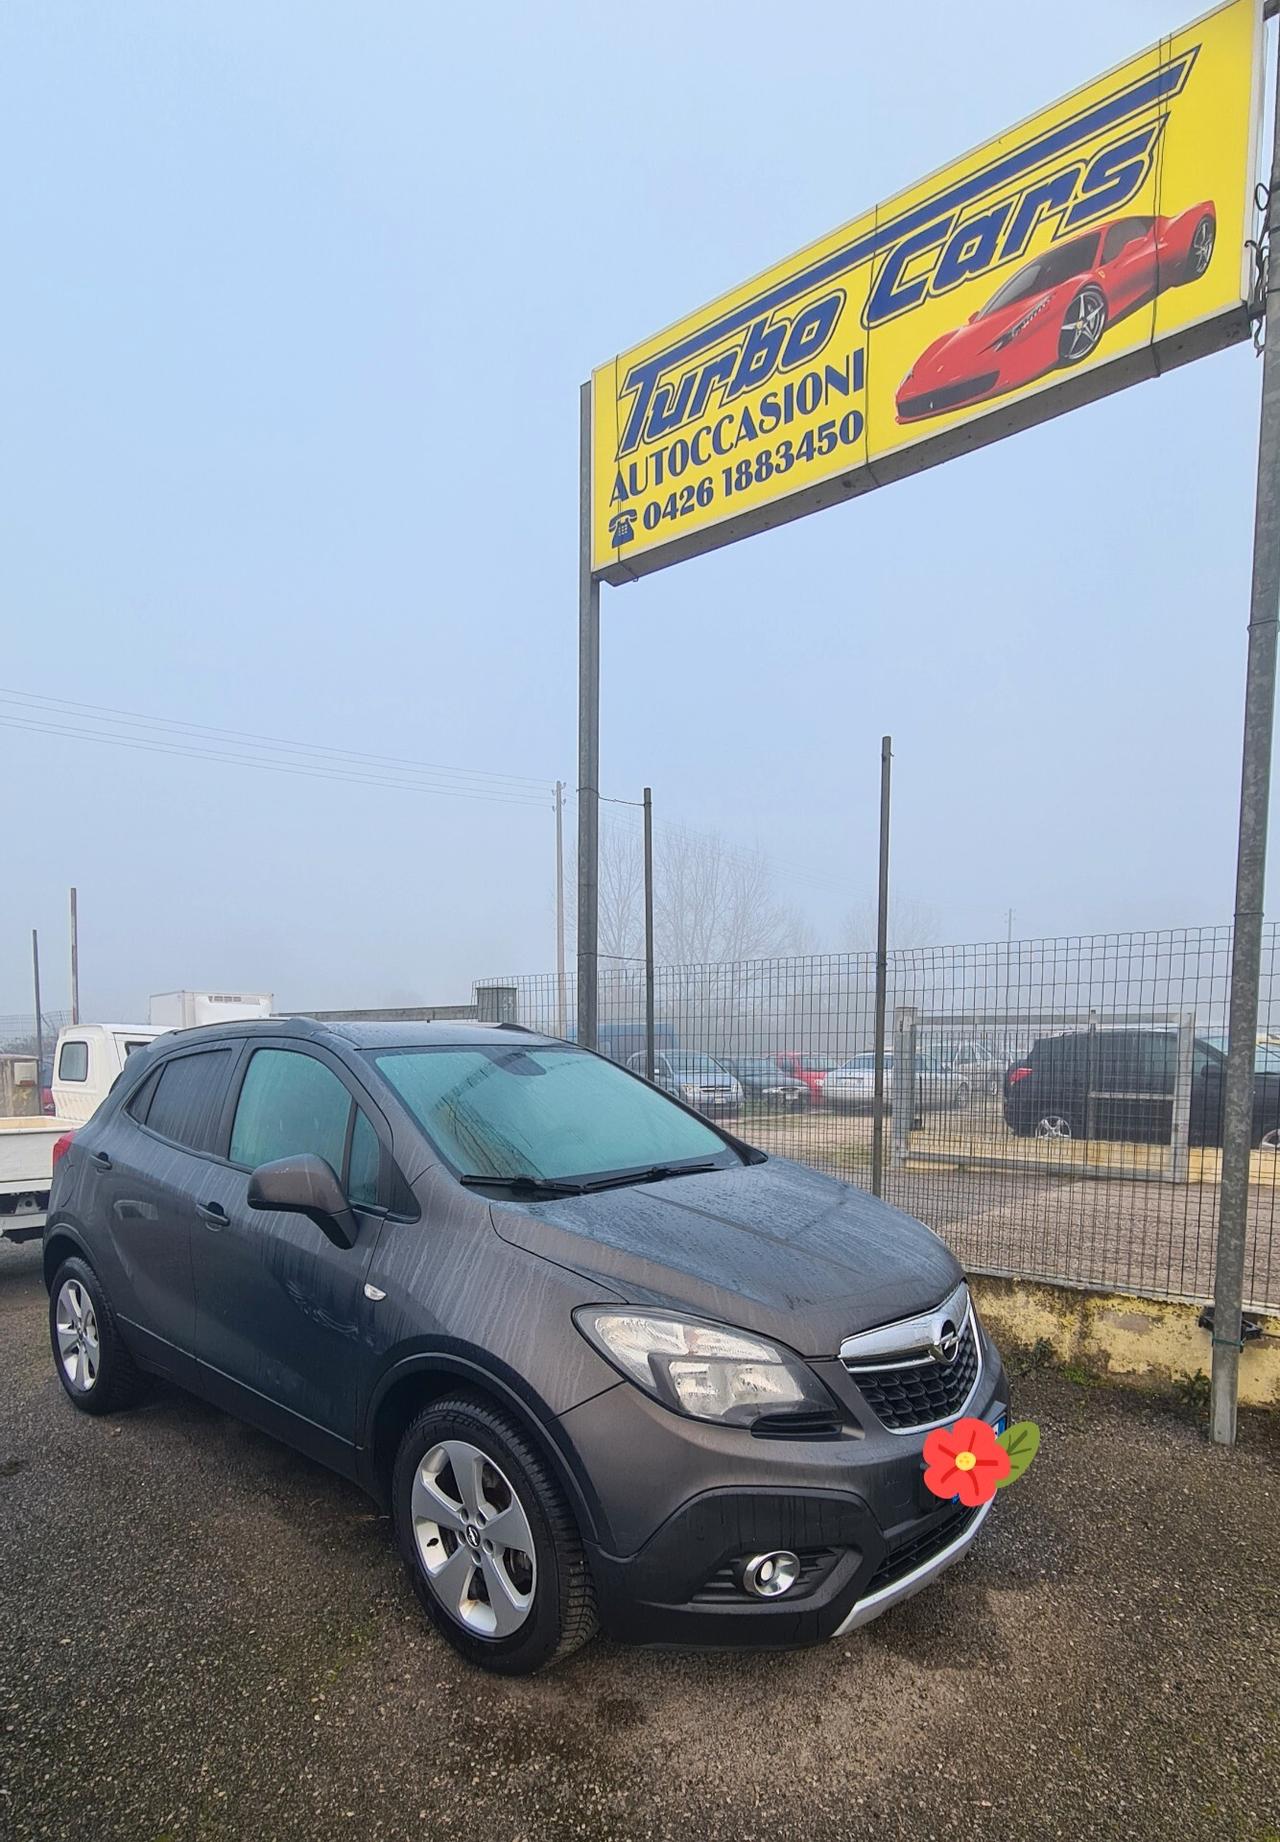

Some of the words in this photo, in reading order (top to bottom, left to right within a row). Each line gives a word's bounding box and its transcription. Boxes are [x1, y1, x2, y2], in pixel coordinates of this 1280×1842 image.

[615, 288, 847, 462] Turbo
[859, 112, 1171, 330] Cars
[609, 347, 864, 507] AUTOCCASIONI
[643, 476, 714, 530] 0426
[721, 410, 864, 497] 1883450
